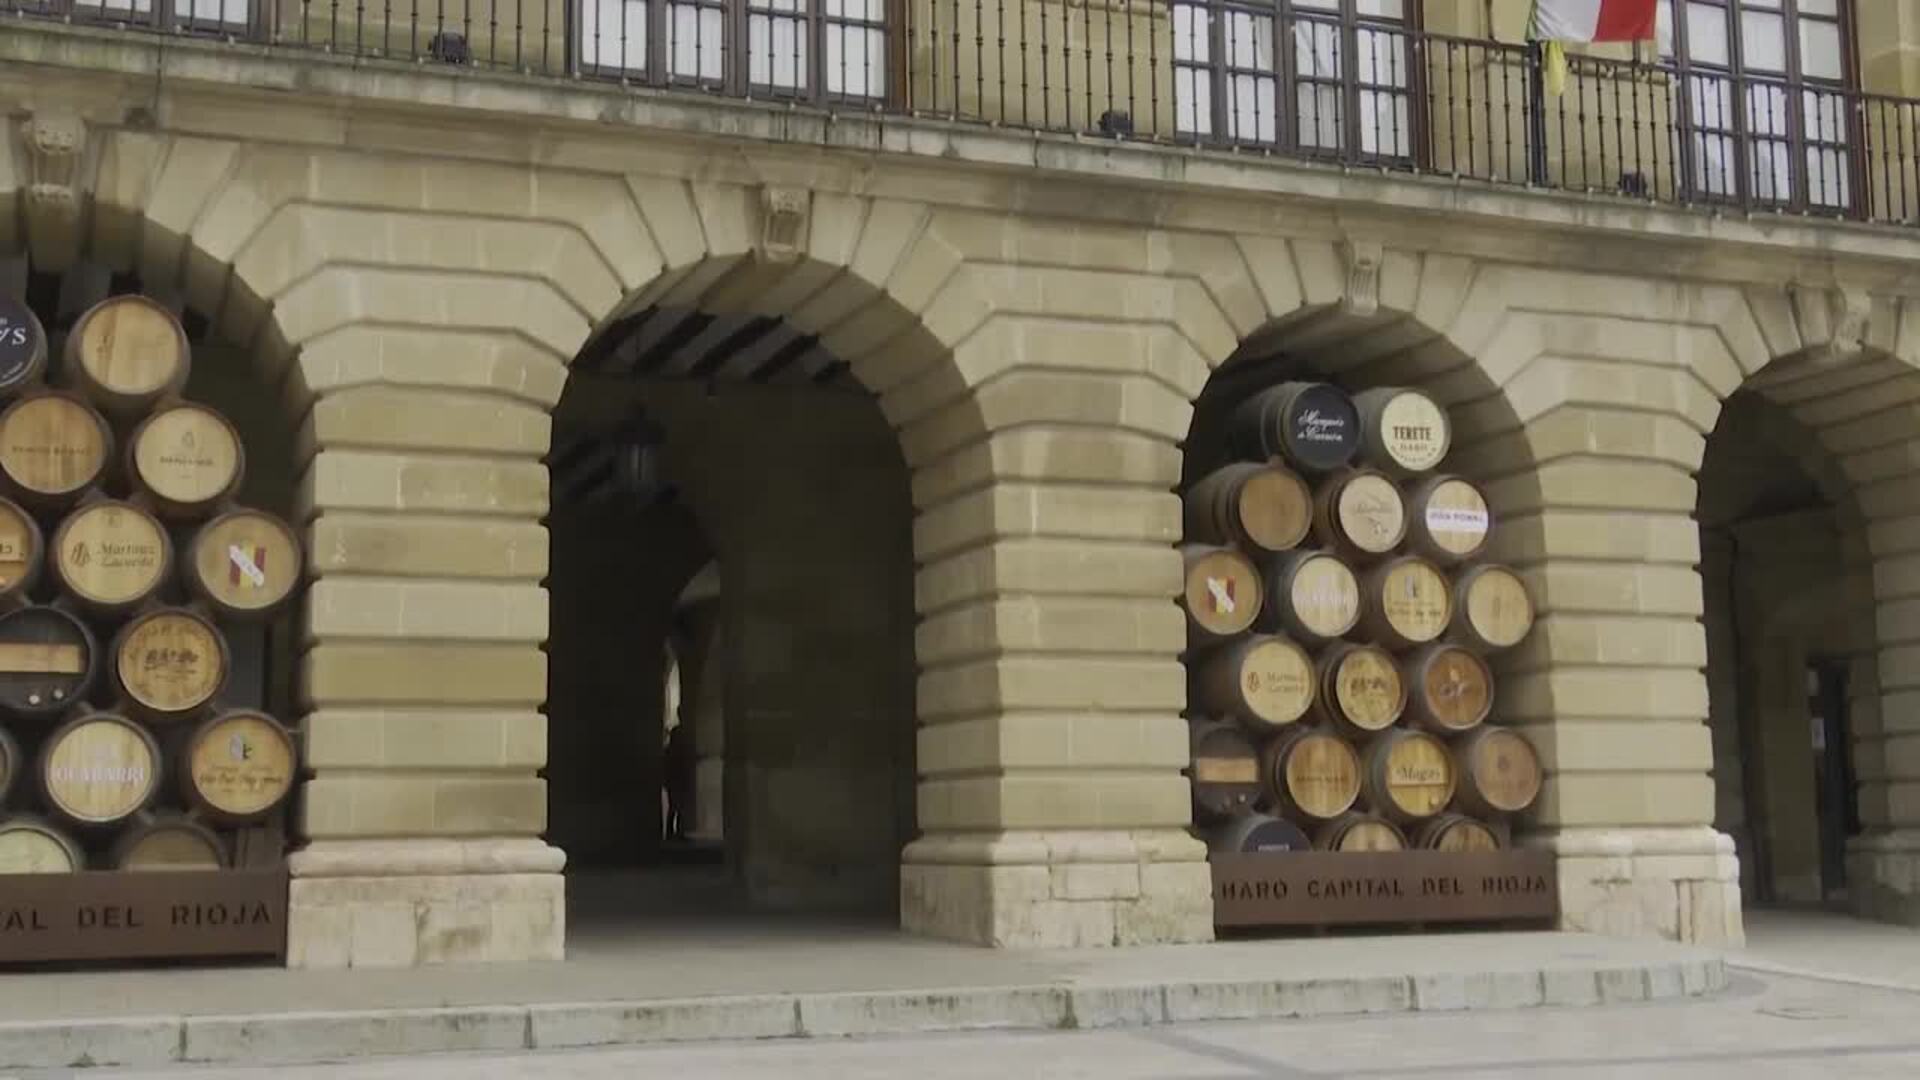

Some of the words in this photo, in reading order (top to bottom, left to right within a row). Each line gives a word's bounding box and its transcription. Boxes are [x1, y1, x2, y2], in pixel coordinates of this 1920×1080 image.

[1392, 426, 1432, 441] TERETE
[1222, 879, 1288, 899] HARO
[1307, 878, 1404, 898] CAPITAL
[1421, 877, 1464, 896] DEL
[1482, 875, 1547, 894] RIOJA
[0, 908, 49, 931] AL
[78, 906, 144, 930] DEL
[171, 903, 272, 926] RIOJA
